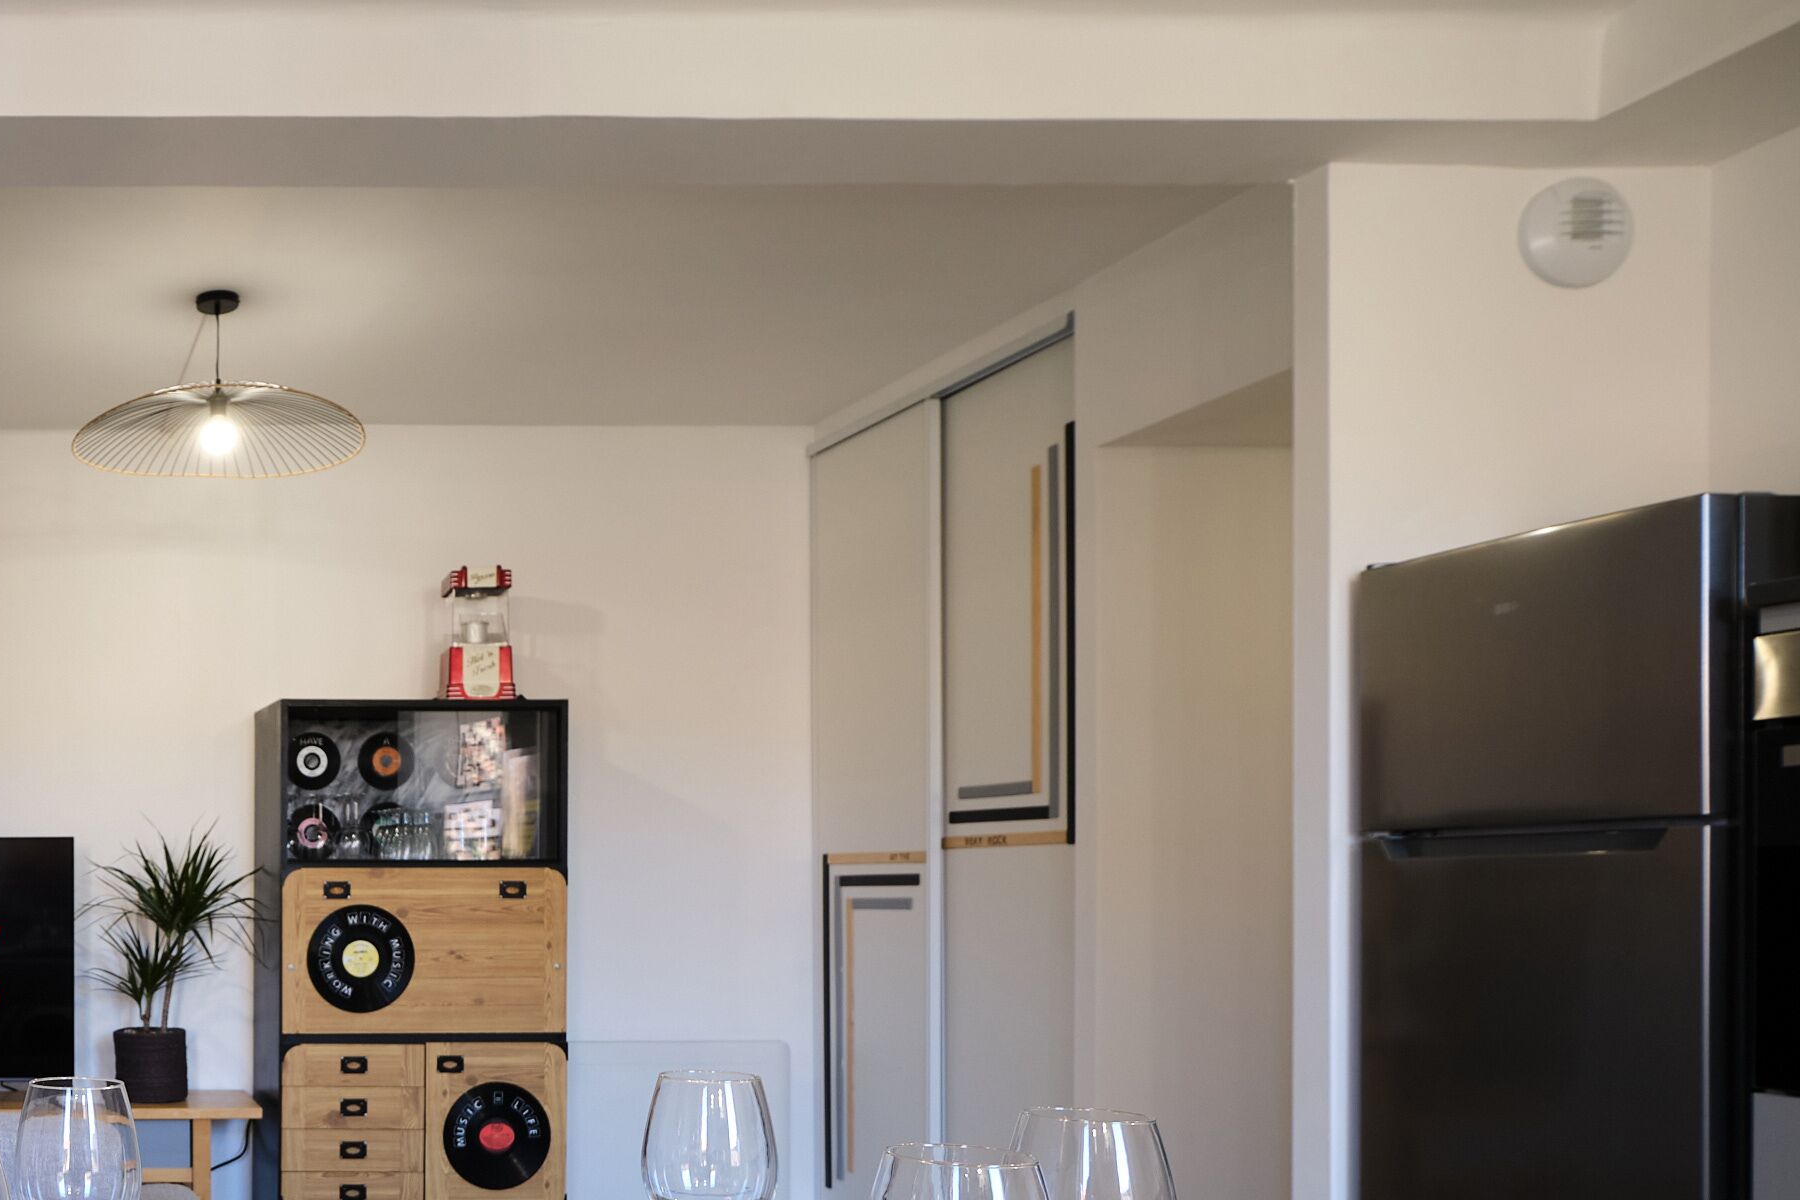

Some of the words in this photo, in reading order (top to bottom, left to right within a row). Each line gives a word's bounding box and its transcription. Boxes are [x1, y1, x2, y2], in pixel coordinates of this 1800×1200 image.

[299, 737, 324, 746] HAVE
[321, 926, 353, 997] WORKING
[346, 914, 388, 933] WITH
[382, 938, 402, 989] MUSIC
[456, 1099, 483, 1148] MUSIC
[512, 1100, 538, 1135] LIFE
